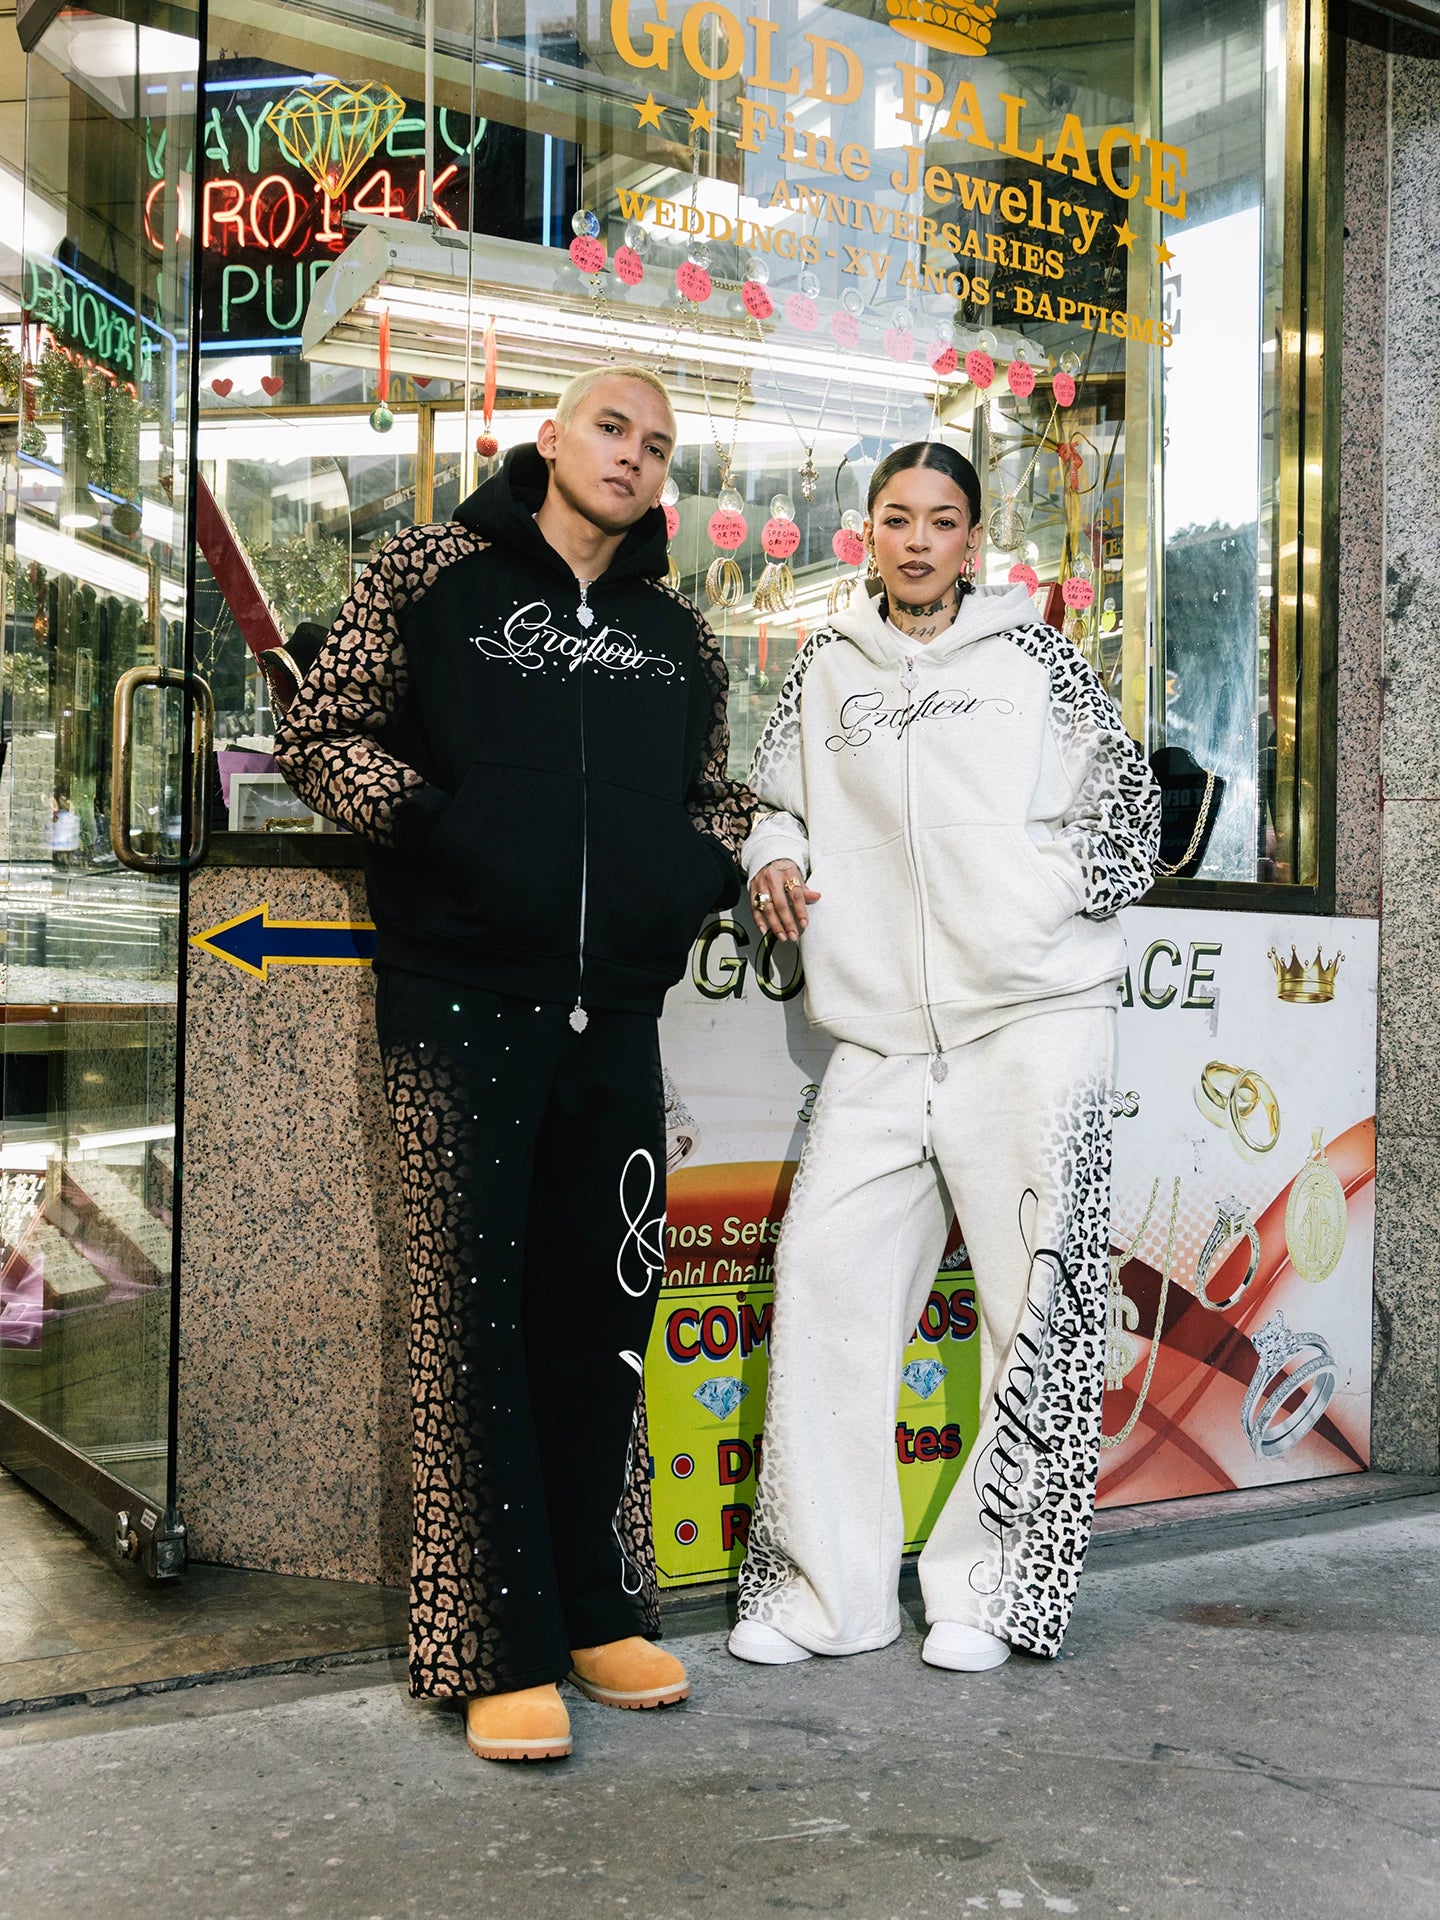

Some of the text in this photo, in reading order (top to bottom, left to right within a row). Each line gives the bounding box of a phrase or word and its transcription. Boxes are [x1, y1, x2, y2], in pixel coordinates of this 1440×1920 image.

[611, 0, 1188, 221] GOLD PALACE
[736, 96, 870, 181] Fine
[891, 145, 1103, 255] Jewelry
[616, 187, 821, 265] WEDDINGS
[841, 244, 892, 283] XV
[898, 257, 990, 306] AÑOS
[1013, 286, 1174, 348] BAPTISMS
[770, 180, 1065, 281] ANNIVERSARIES
[721, 1216, 781, 1246] Sets
